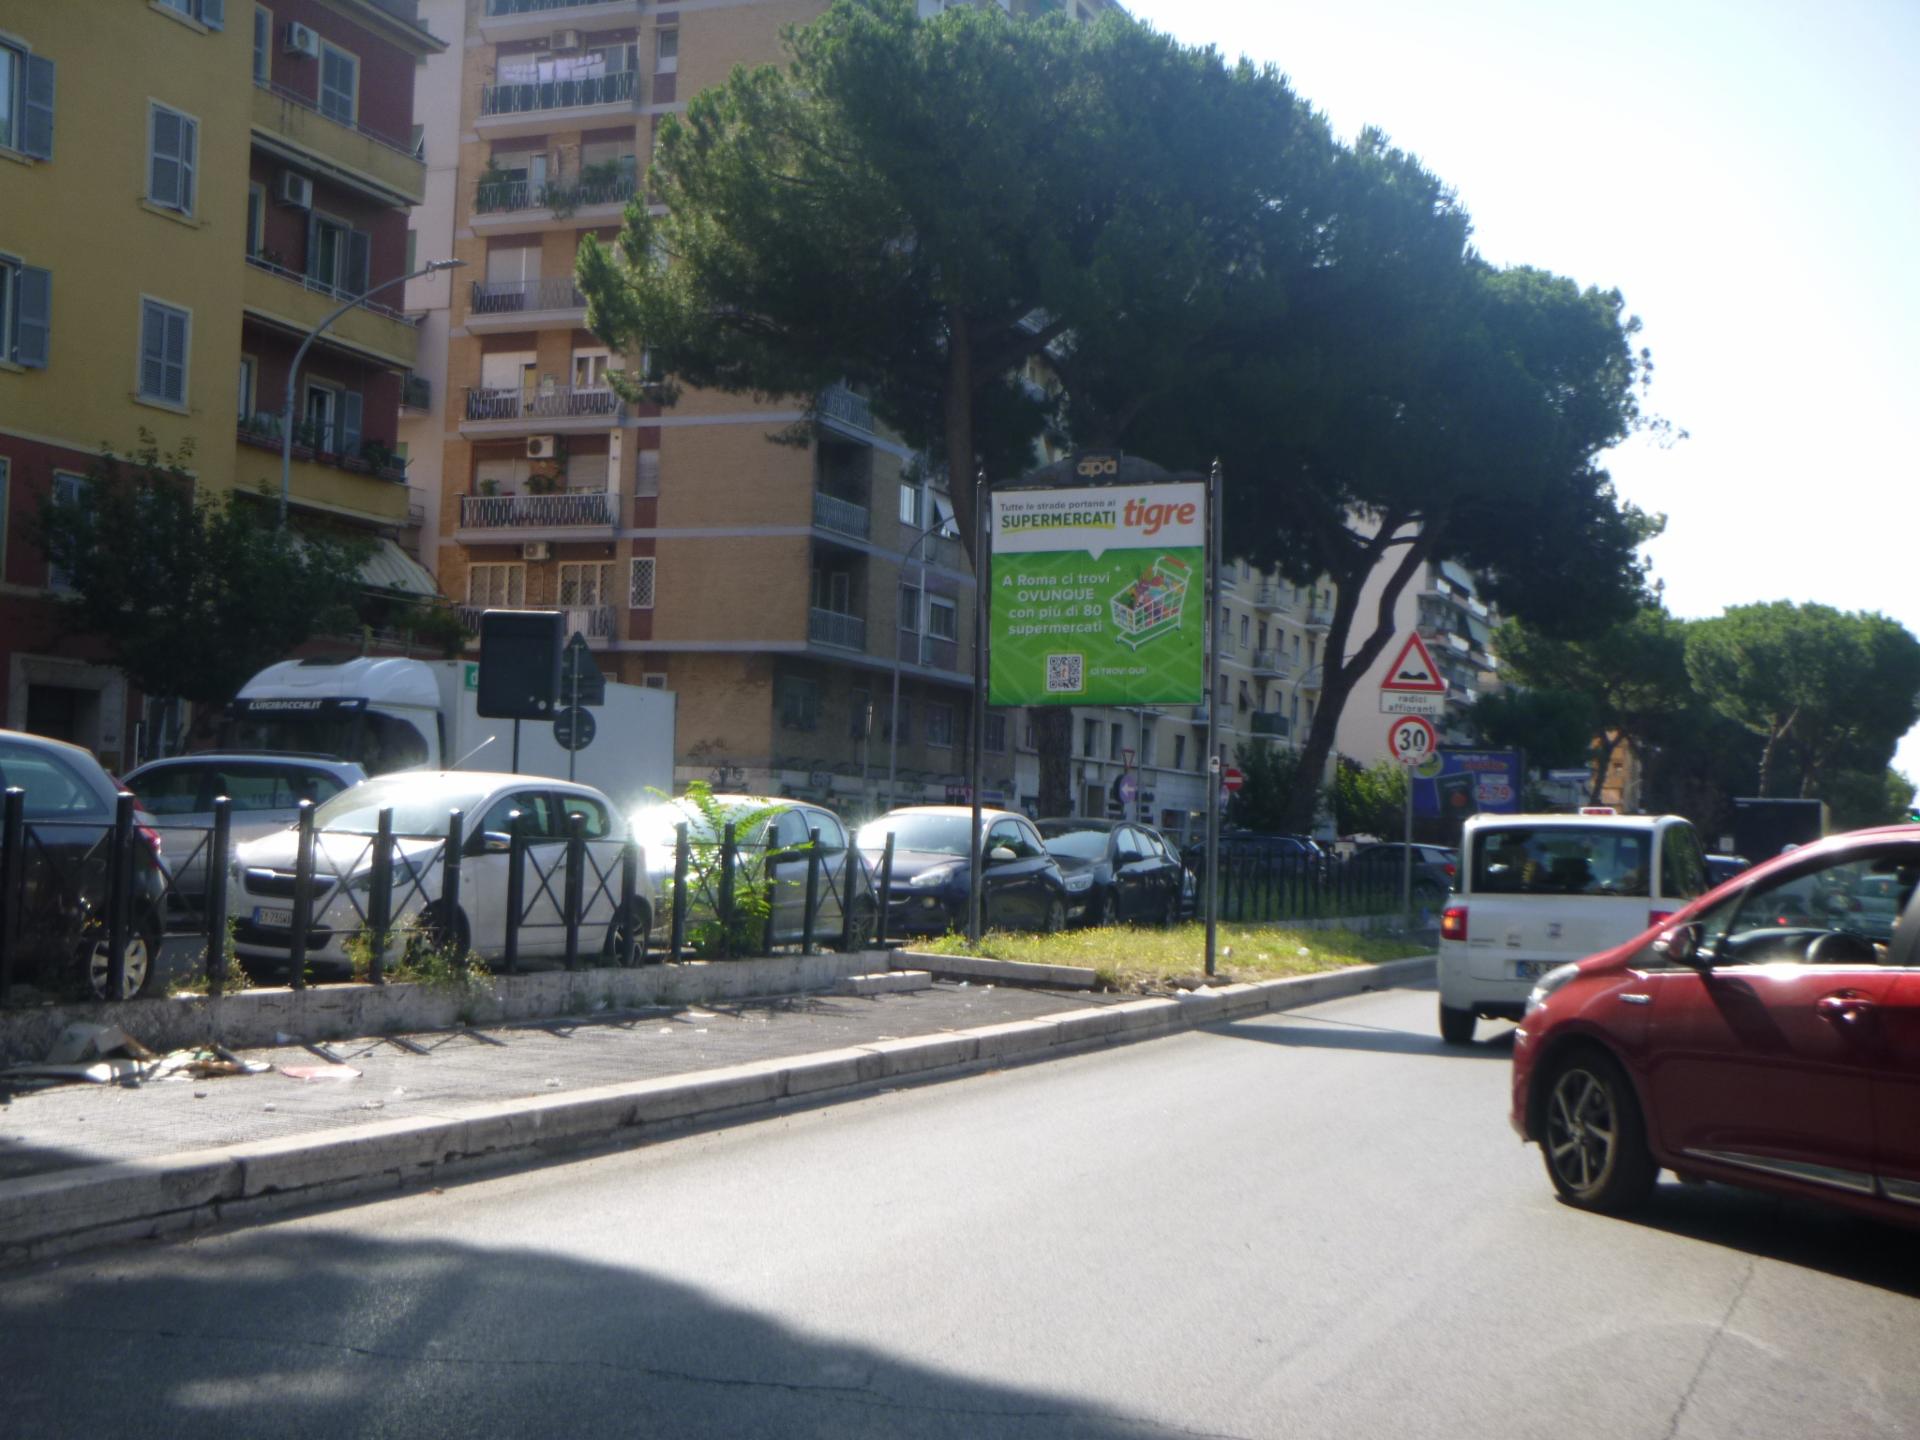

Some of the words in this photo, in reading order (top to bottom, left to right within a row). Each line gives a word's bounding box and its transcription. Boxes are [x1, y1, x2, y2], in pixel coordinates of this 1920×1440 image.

[1000, 503, 1024, 512] Tutte
[1026, 502, 1035, 511] le
[1036, 501, 1066, 511] strade
[1001, 511, 1116, 529] SUPERMERCATI
[1123, 497, 1196, 536] tigre
[1002, 576, 1013, 587] A
[1018, 574, 1057, 586] Roma
[1061, 573, 1073, 585] ci
[1078, 573, 1110, 585] trovi
[1017, 589, 1095, 602] OVUNQUE
[1008, 608, 1034, 619] con
[1065, 605, 1078, 617] di
[1083, 604, 1102, 616] 80
[1008, 621, 1103, 637] supermercati
[1398, 694, 1427, 703] radici
[1388, 703, 1437, 714] affioranti
[1399, 728, 1426, 752] 30
